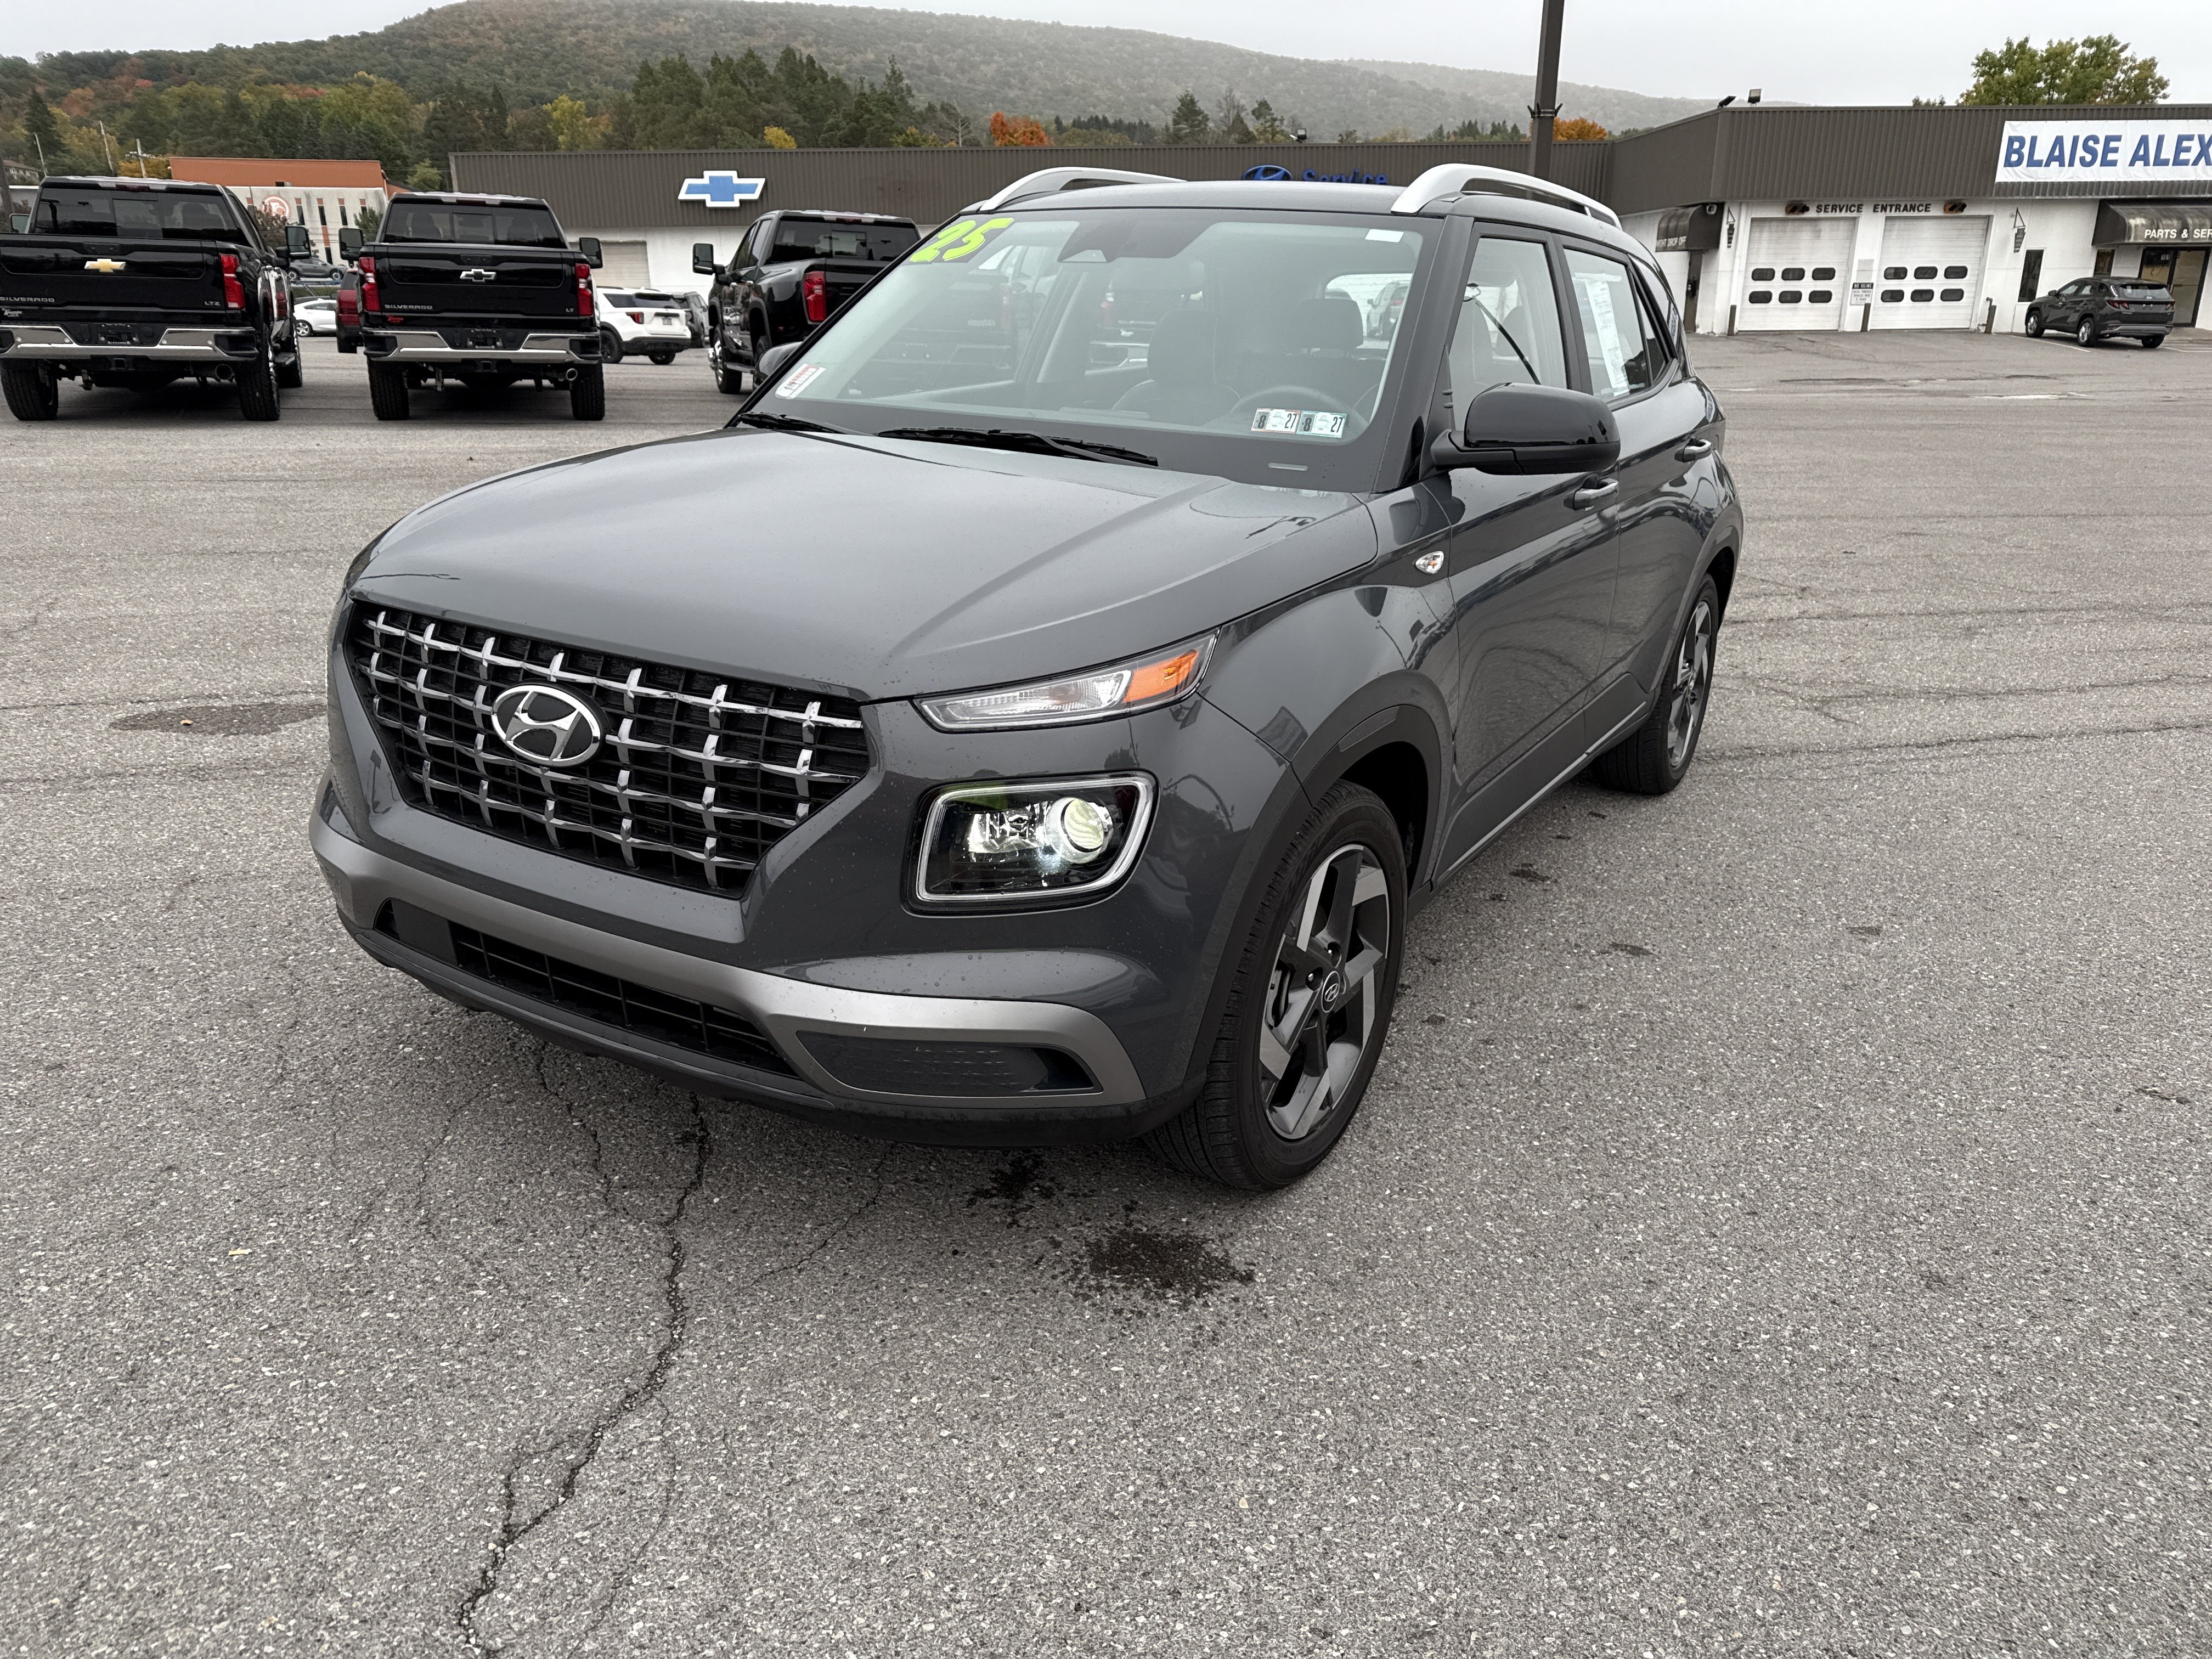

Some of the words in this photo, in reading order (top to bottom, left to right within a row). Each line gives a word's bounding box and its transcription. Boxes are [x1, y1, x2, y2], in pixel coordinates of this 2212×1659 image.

[2004, 134, 2122, 167] BLAISE
[2129, 134, 2212, 167] ALEX
[1303, 168, 1387, 184] Service
[1816, 204, 1864, 213] SERVICE
[1873, 204, 1931, 212] ENTRANCE
[910, 218, 1014, 262] 25
[2144, 229, 2177, 238] PARTS
[2181, 229, 2188, 238] &
[2193, 229, 2212, 238] SER
[1257, 415, 1267, 429] 8
[1284, 413, 1297, 429] 27
[1303, 417, 1312, 432] 8
[1330, 416, 1344, 433] 27
